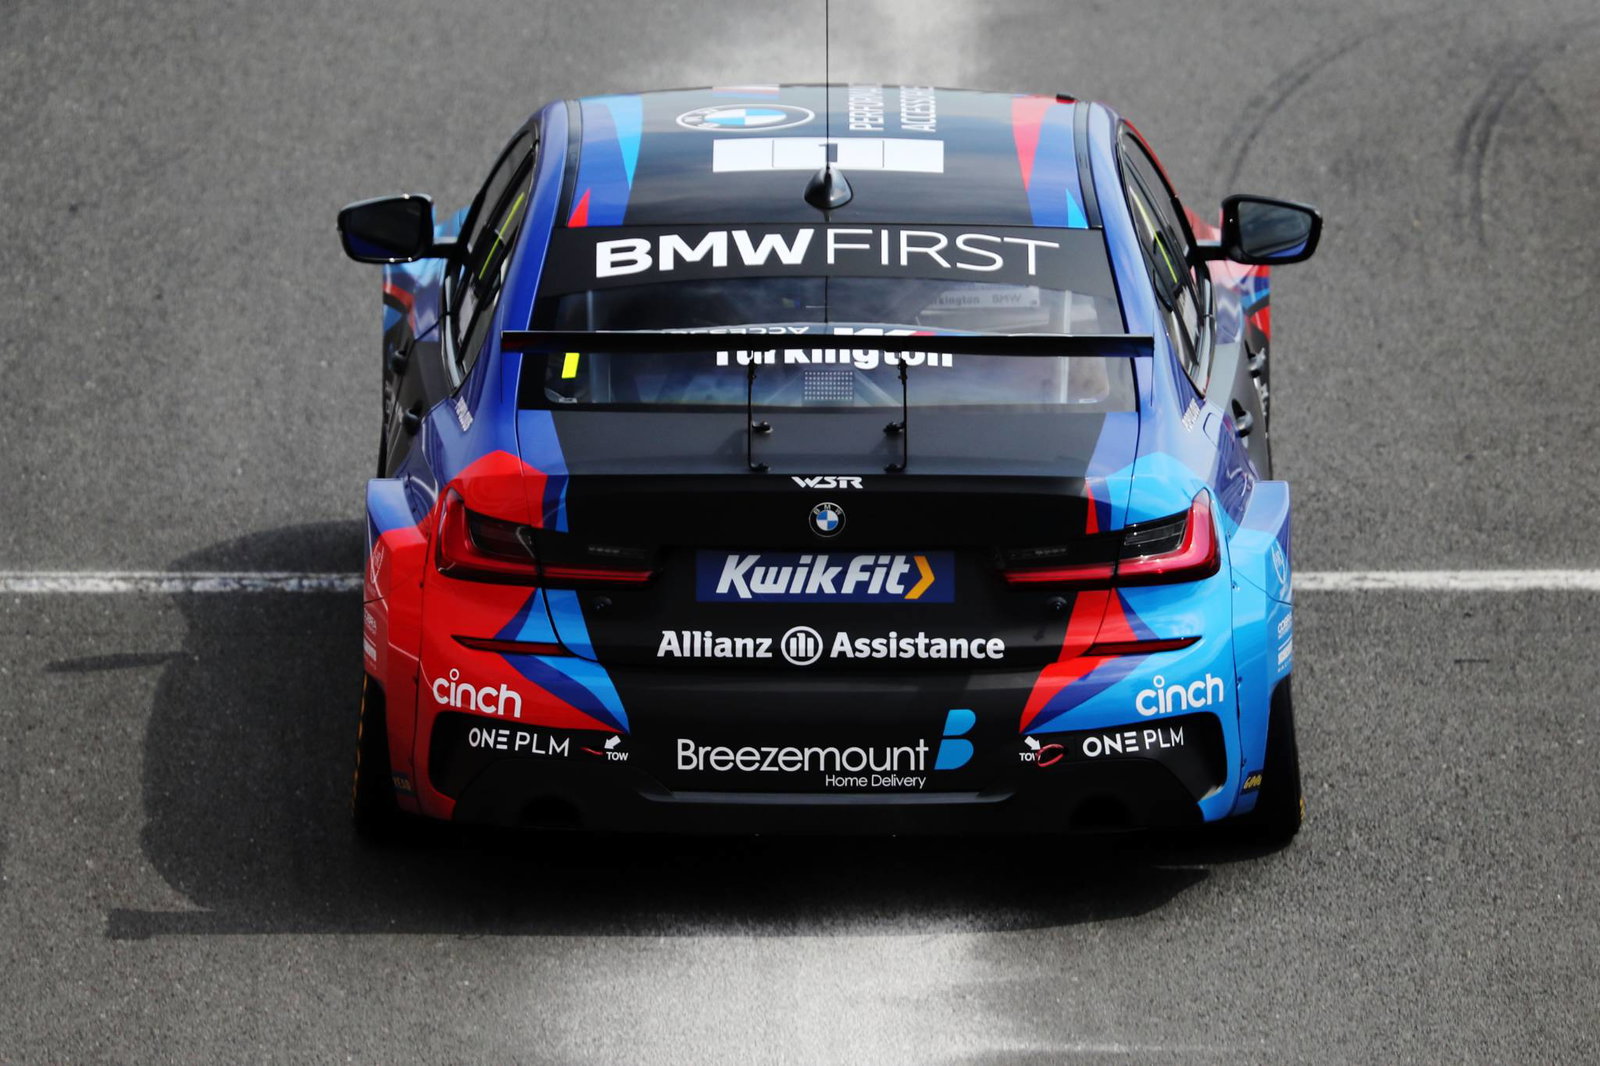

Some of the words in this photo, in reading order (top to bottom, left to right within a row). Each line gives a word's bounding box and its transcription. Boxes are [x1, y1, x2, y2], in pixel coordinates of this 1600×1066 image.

[596, 229, 814, 278] BMW
[826, 229, 1060, 277] FIRST
[791, 476, 864, 489] WSR
[656, 630, 773, 658] Allianz
[829, 631, 1006, 659] Assistance
[432, 668, 522, 718] cinch
[1136, 674, 1223, 716] cinch
[468, 727, 511, 751] ONE
[514, 731, 570, 757] PLM
[605, 751, 629, 762] TOW
[677, 738, 929, 771] Breezemount
[1082, 730, 1140, 757] ONE
[1143, 726, 1184, 750] PLM
[825, 774, 868, 787] Home
[871, 774, 927, 789] Delivery
